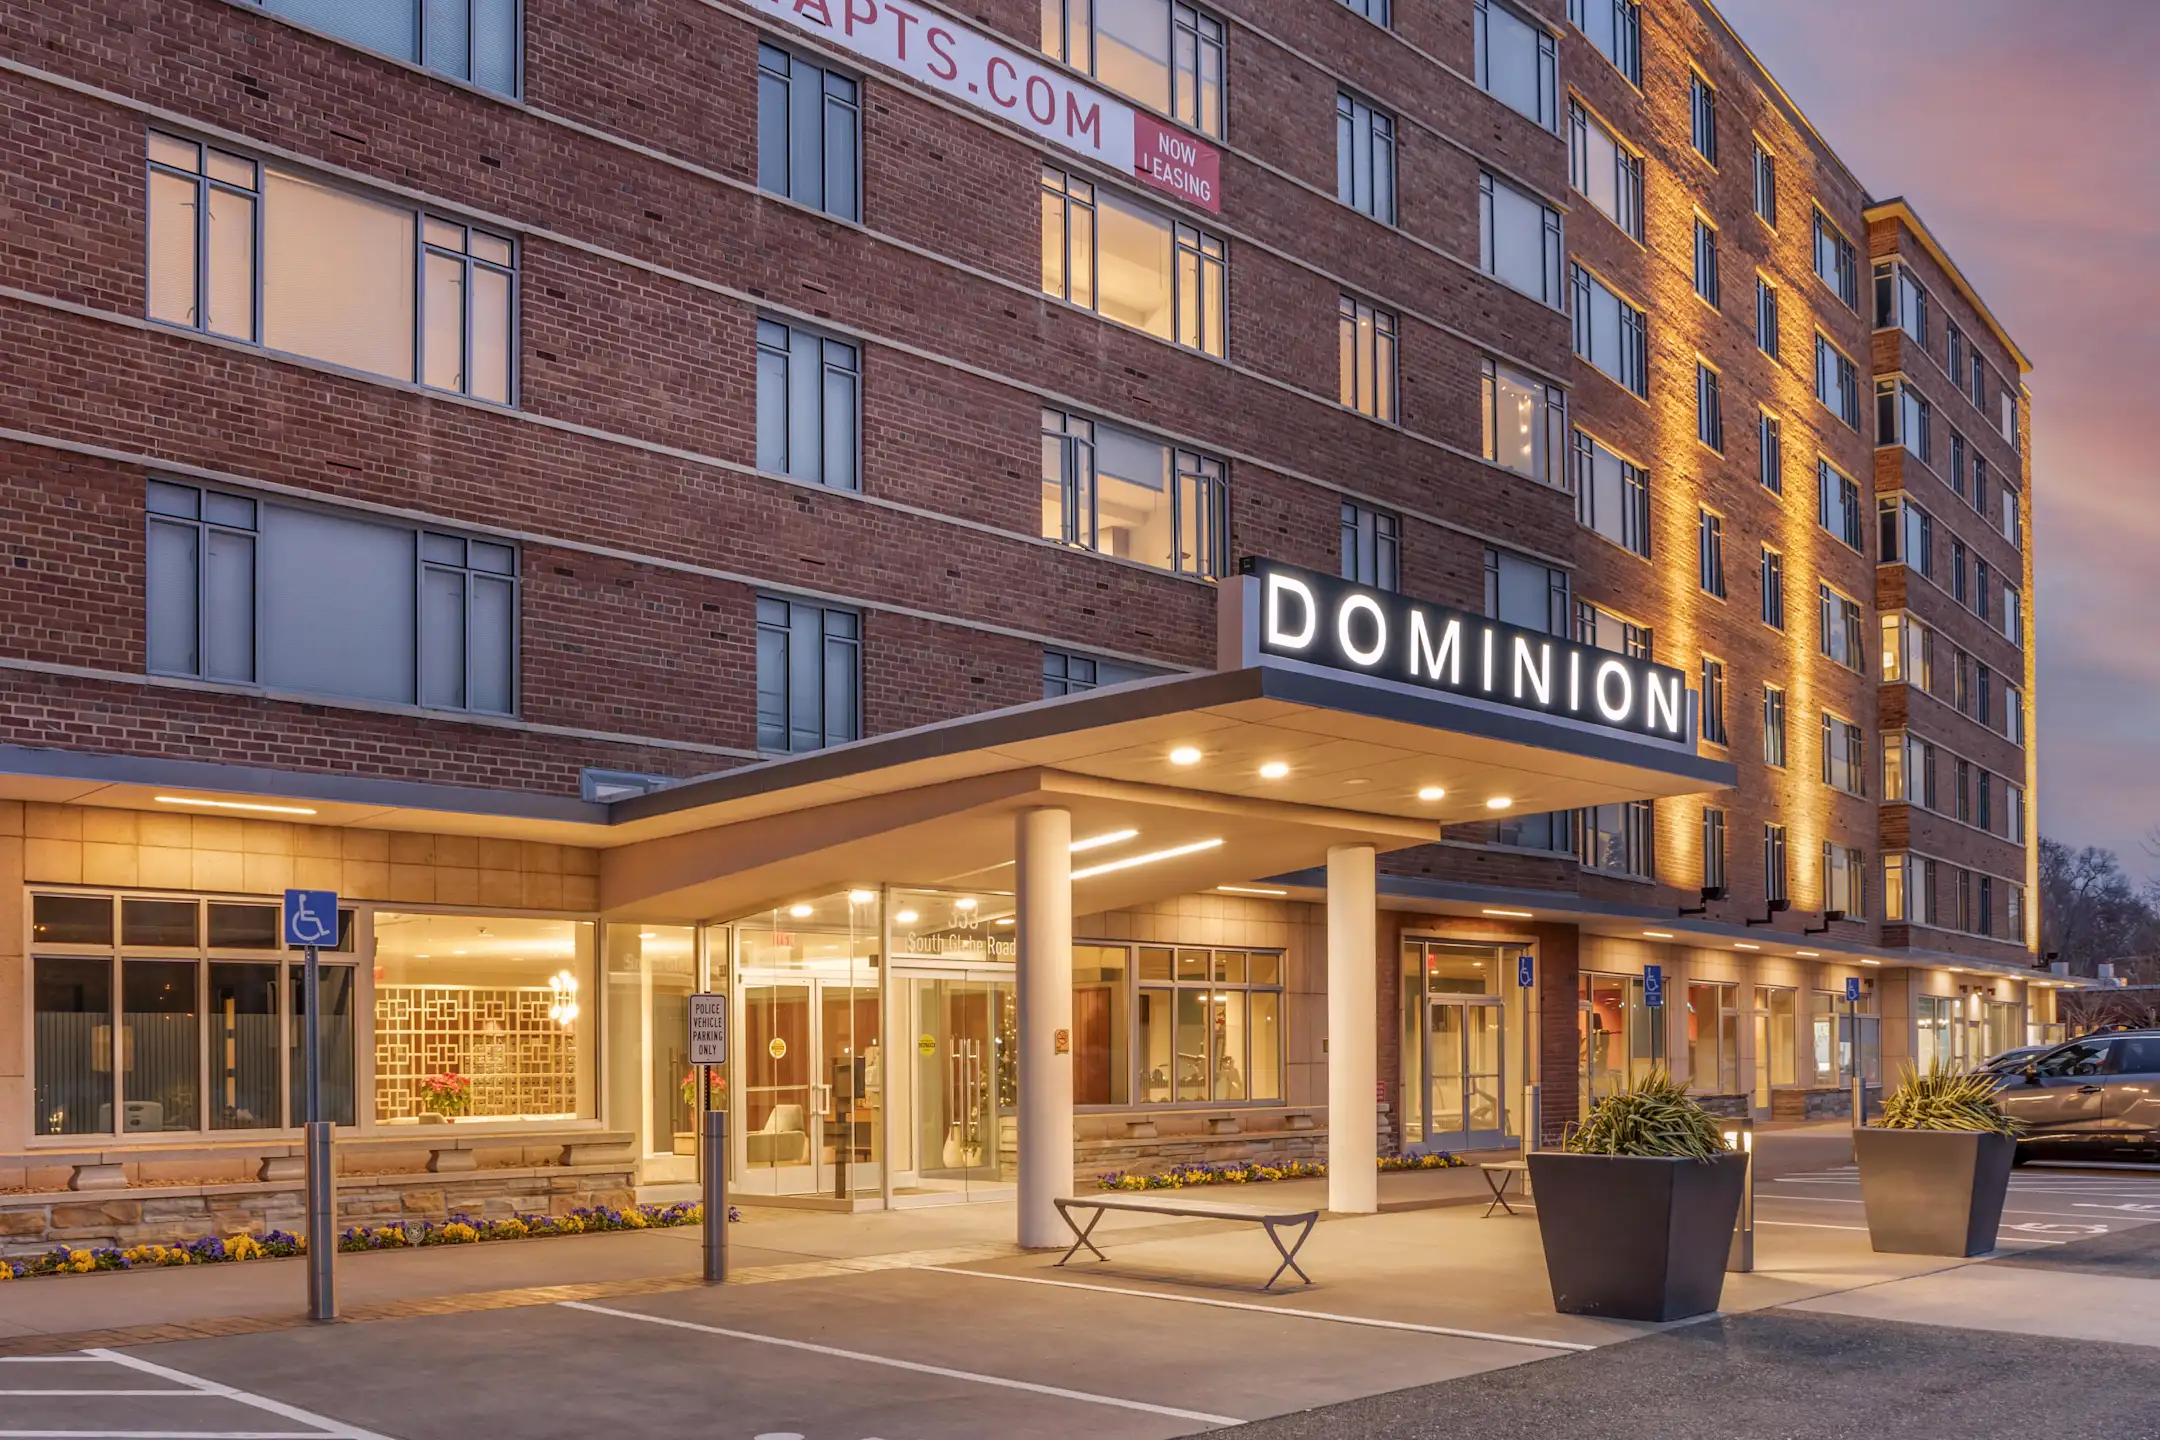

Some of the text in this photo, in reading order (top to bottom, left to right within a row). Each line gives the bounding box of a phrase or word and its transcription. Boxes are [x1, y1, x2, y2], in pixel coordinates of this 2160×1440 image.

[1159, 131, 1196, 168] NOW
[1144, 152, 1211, 202] LEASING
[1268, 573, 1679, 734] DOMINION
[908, 932, 944, 953] South
[987, 936, 1016, 956] Road
[695, 1003, 720, 1014] POLICE
[693, 1017, 722, 1028] VEHICLE
[693, 1030, 723, 1042] PARKING
[698, 1044, 717, 1056] ONLY
